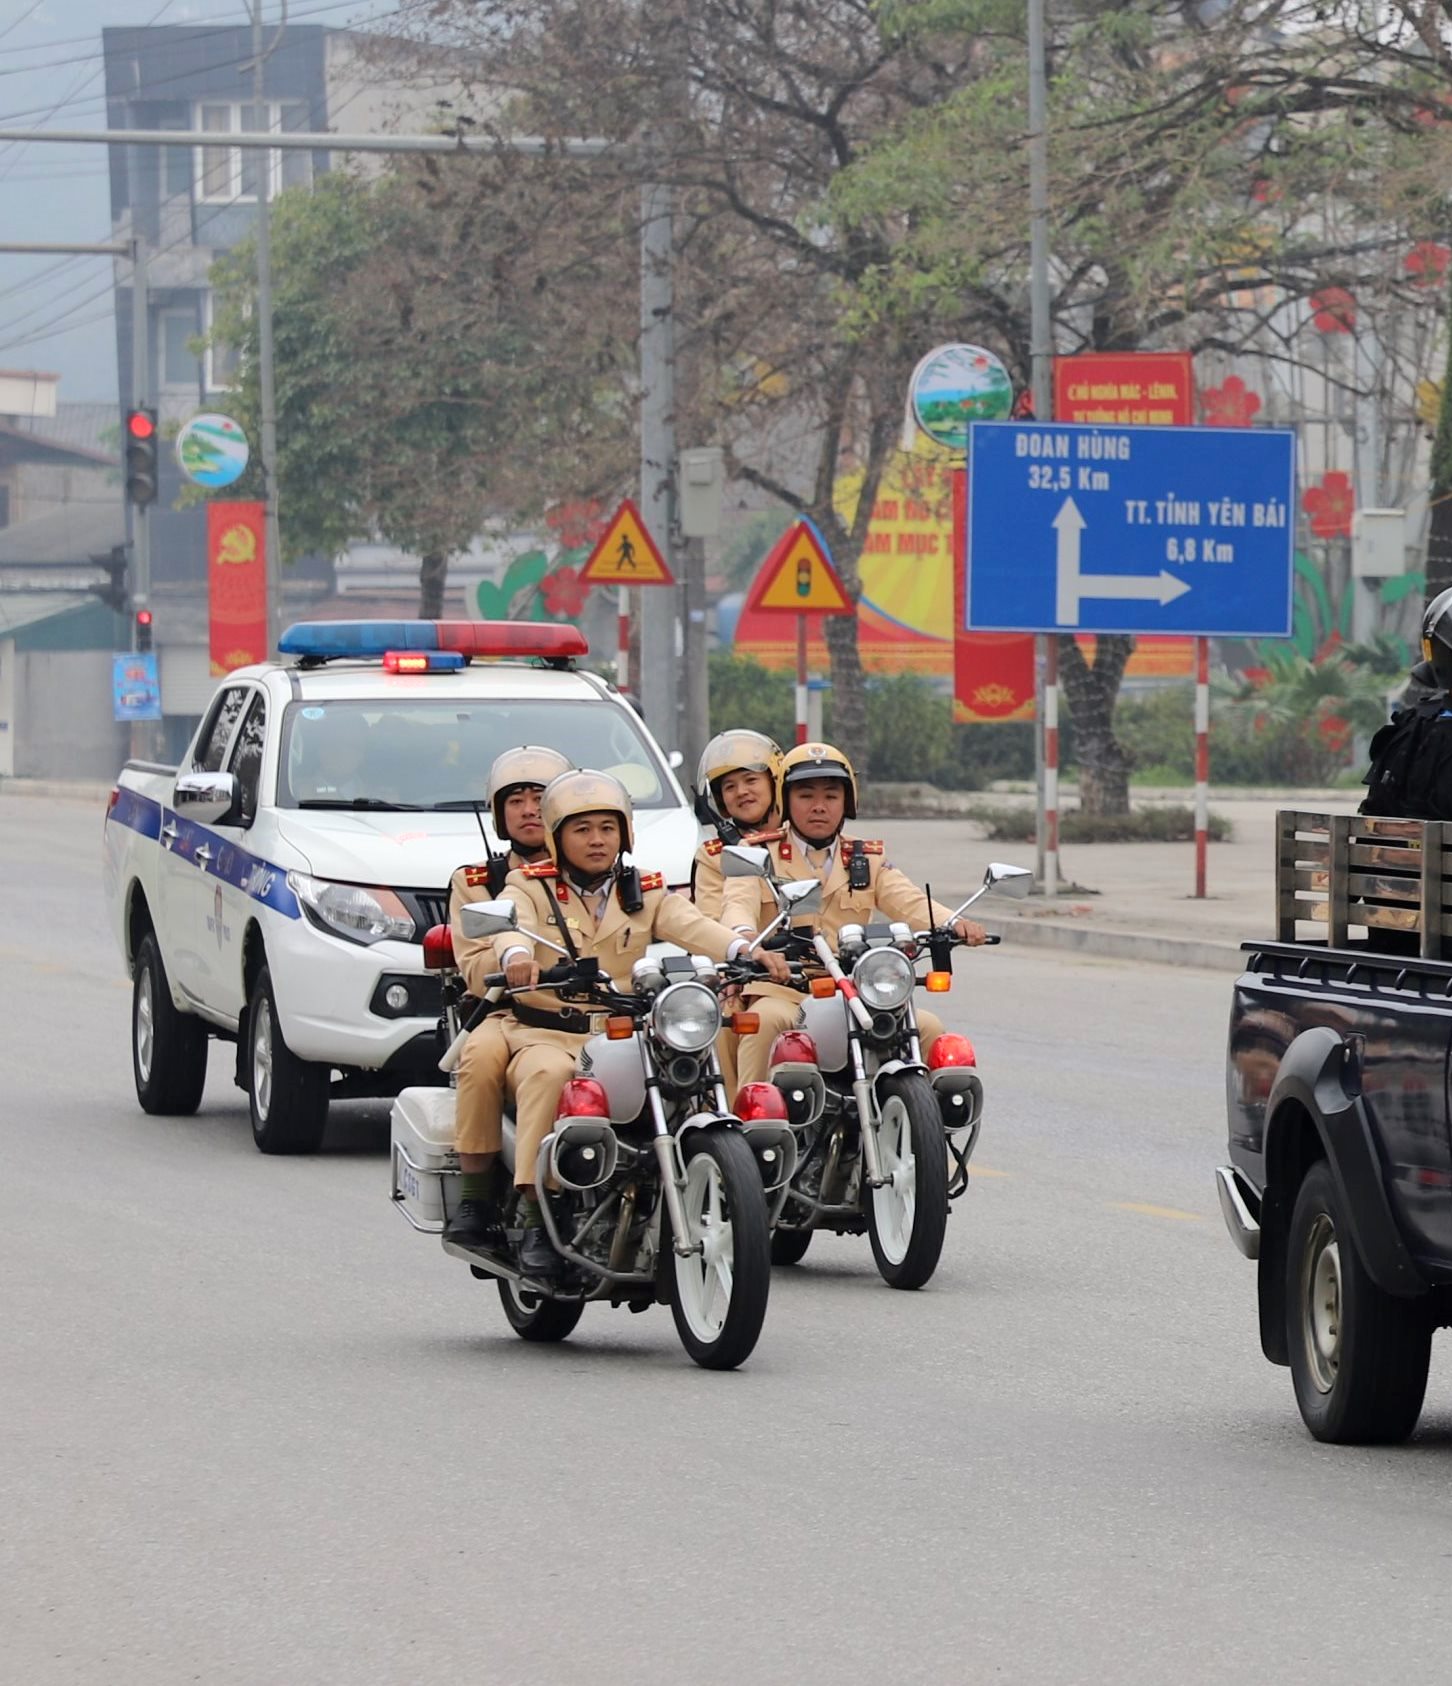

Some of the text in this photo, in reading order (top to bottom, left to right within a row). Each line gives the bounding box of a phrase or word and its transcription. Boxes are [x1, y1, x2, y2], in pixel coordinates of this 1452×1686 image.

[1077, 429, 1130, 460] HÙNG
[1028, 464, 1109, 492] 32,5 Km
[1125, 492, 1286, 528] TT. TỈNH YÊN BÁI
[1166, 537, 1234, 565] 6,8 Km
